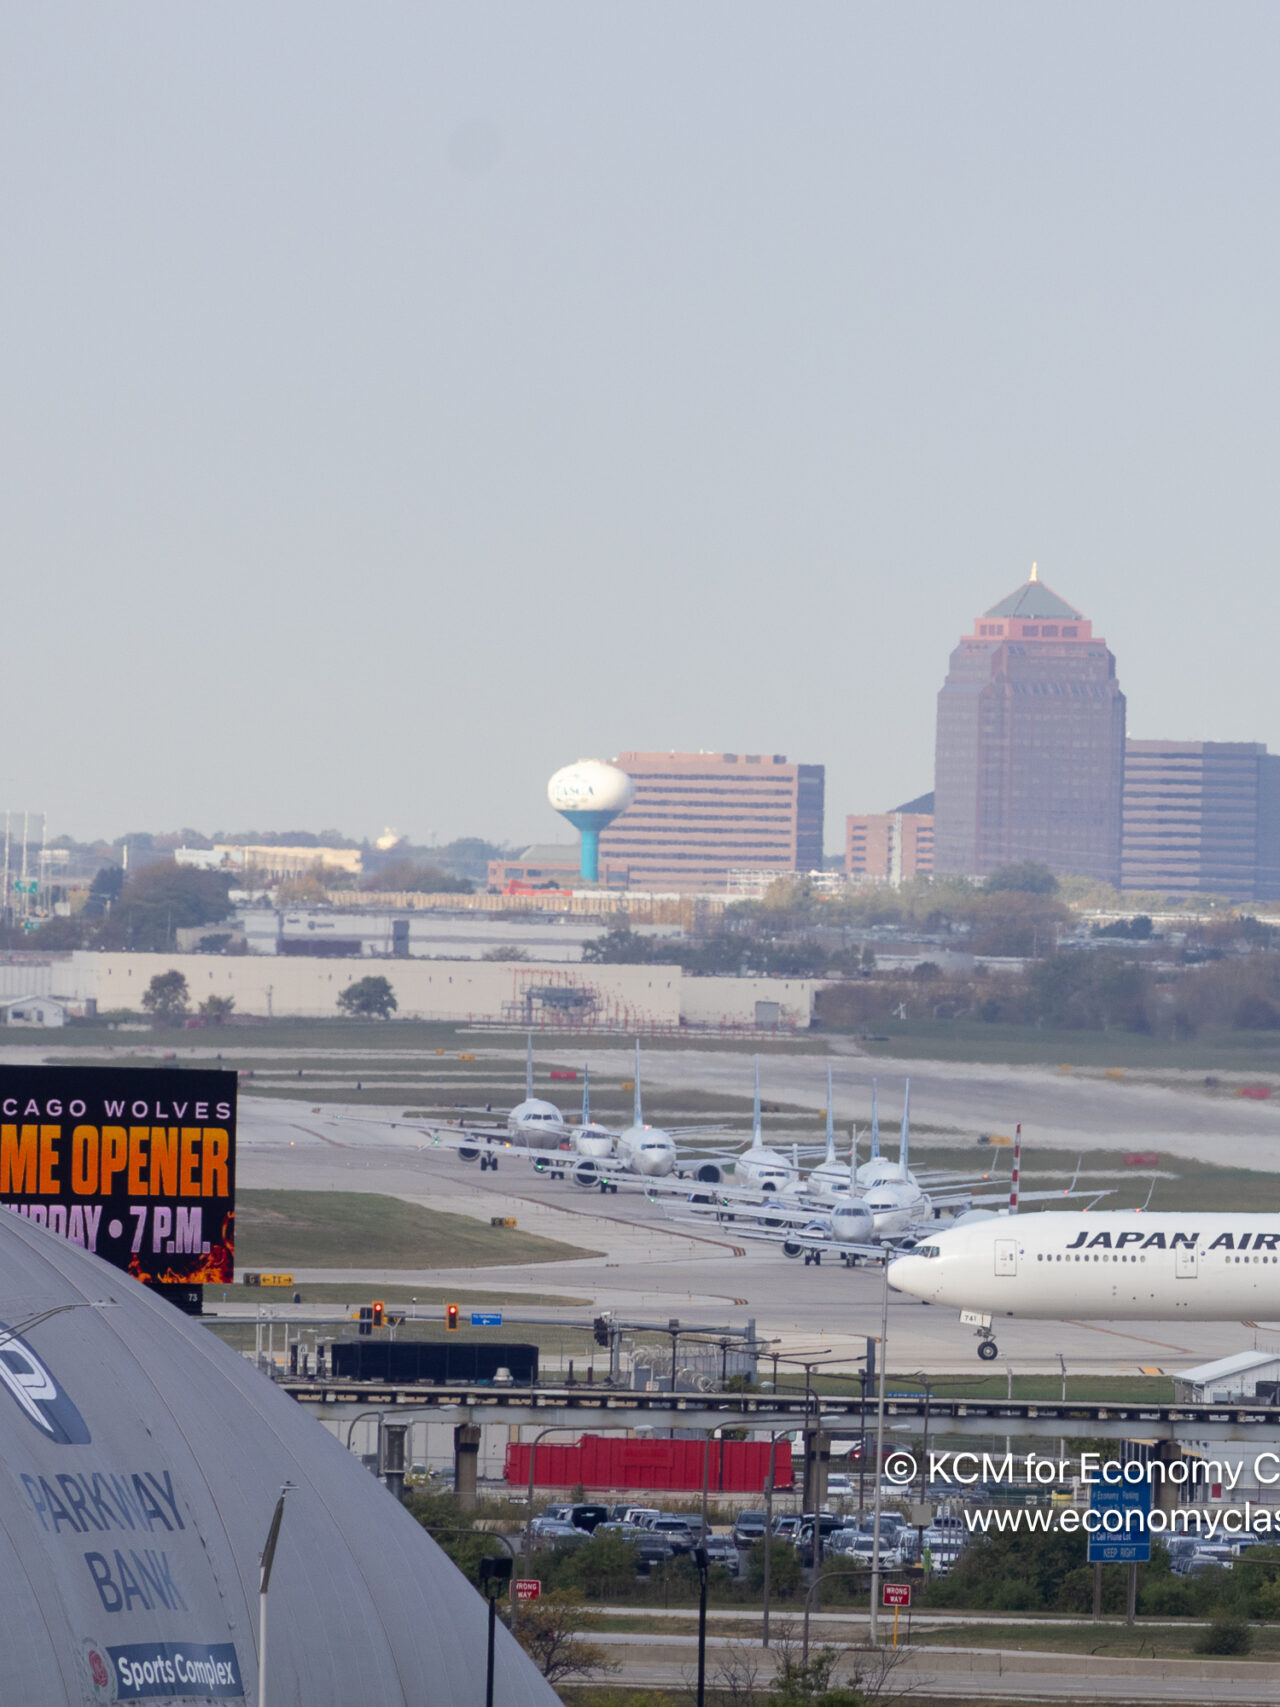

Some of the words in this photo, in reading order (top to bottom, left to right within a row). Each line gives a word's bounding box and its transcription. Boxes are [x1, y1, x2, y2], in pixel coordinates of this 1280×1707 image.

[104, 1100, 231, 1120] WOLVES
[0, 1124, 62, 1195] ME
[71, 1125, 229, 1197] OPENER
[129, 1205, 147, 1253] 7
[153, 1206, 211, 1254] P.M.
[1065, 1231, 1201, 1250] JAPAN
[188, 1293, 199, 1302] 73
[964, 1314, 977, 1322] 741
[20, 1470, 186, 1533] PARKWAY
[1103, 1548, 1118, 1558] KEEP
[1119, 1547, 1137, 1557] RIGHT
[84, 1549, 189, 1613] BANK
[886, 1587, 908, 1596] WRONG
[118, 1655, 176, 1692] Sports
[174, 1653, 236, 1691] Complex
